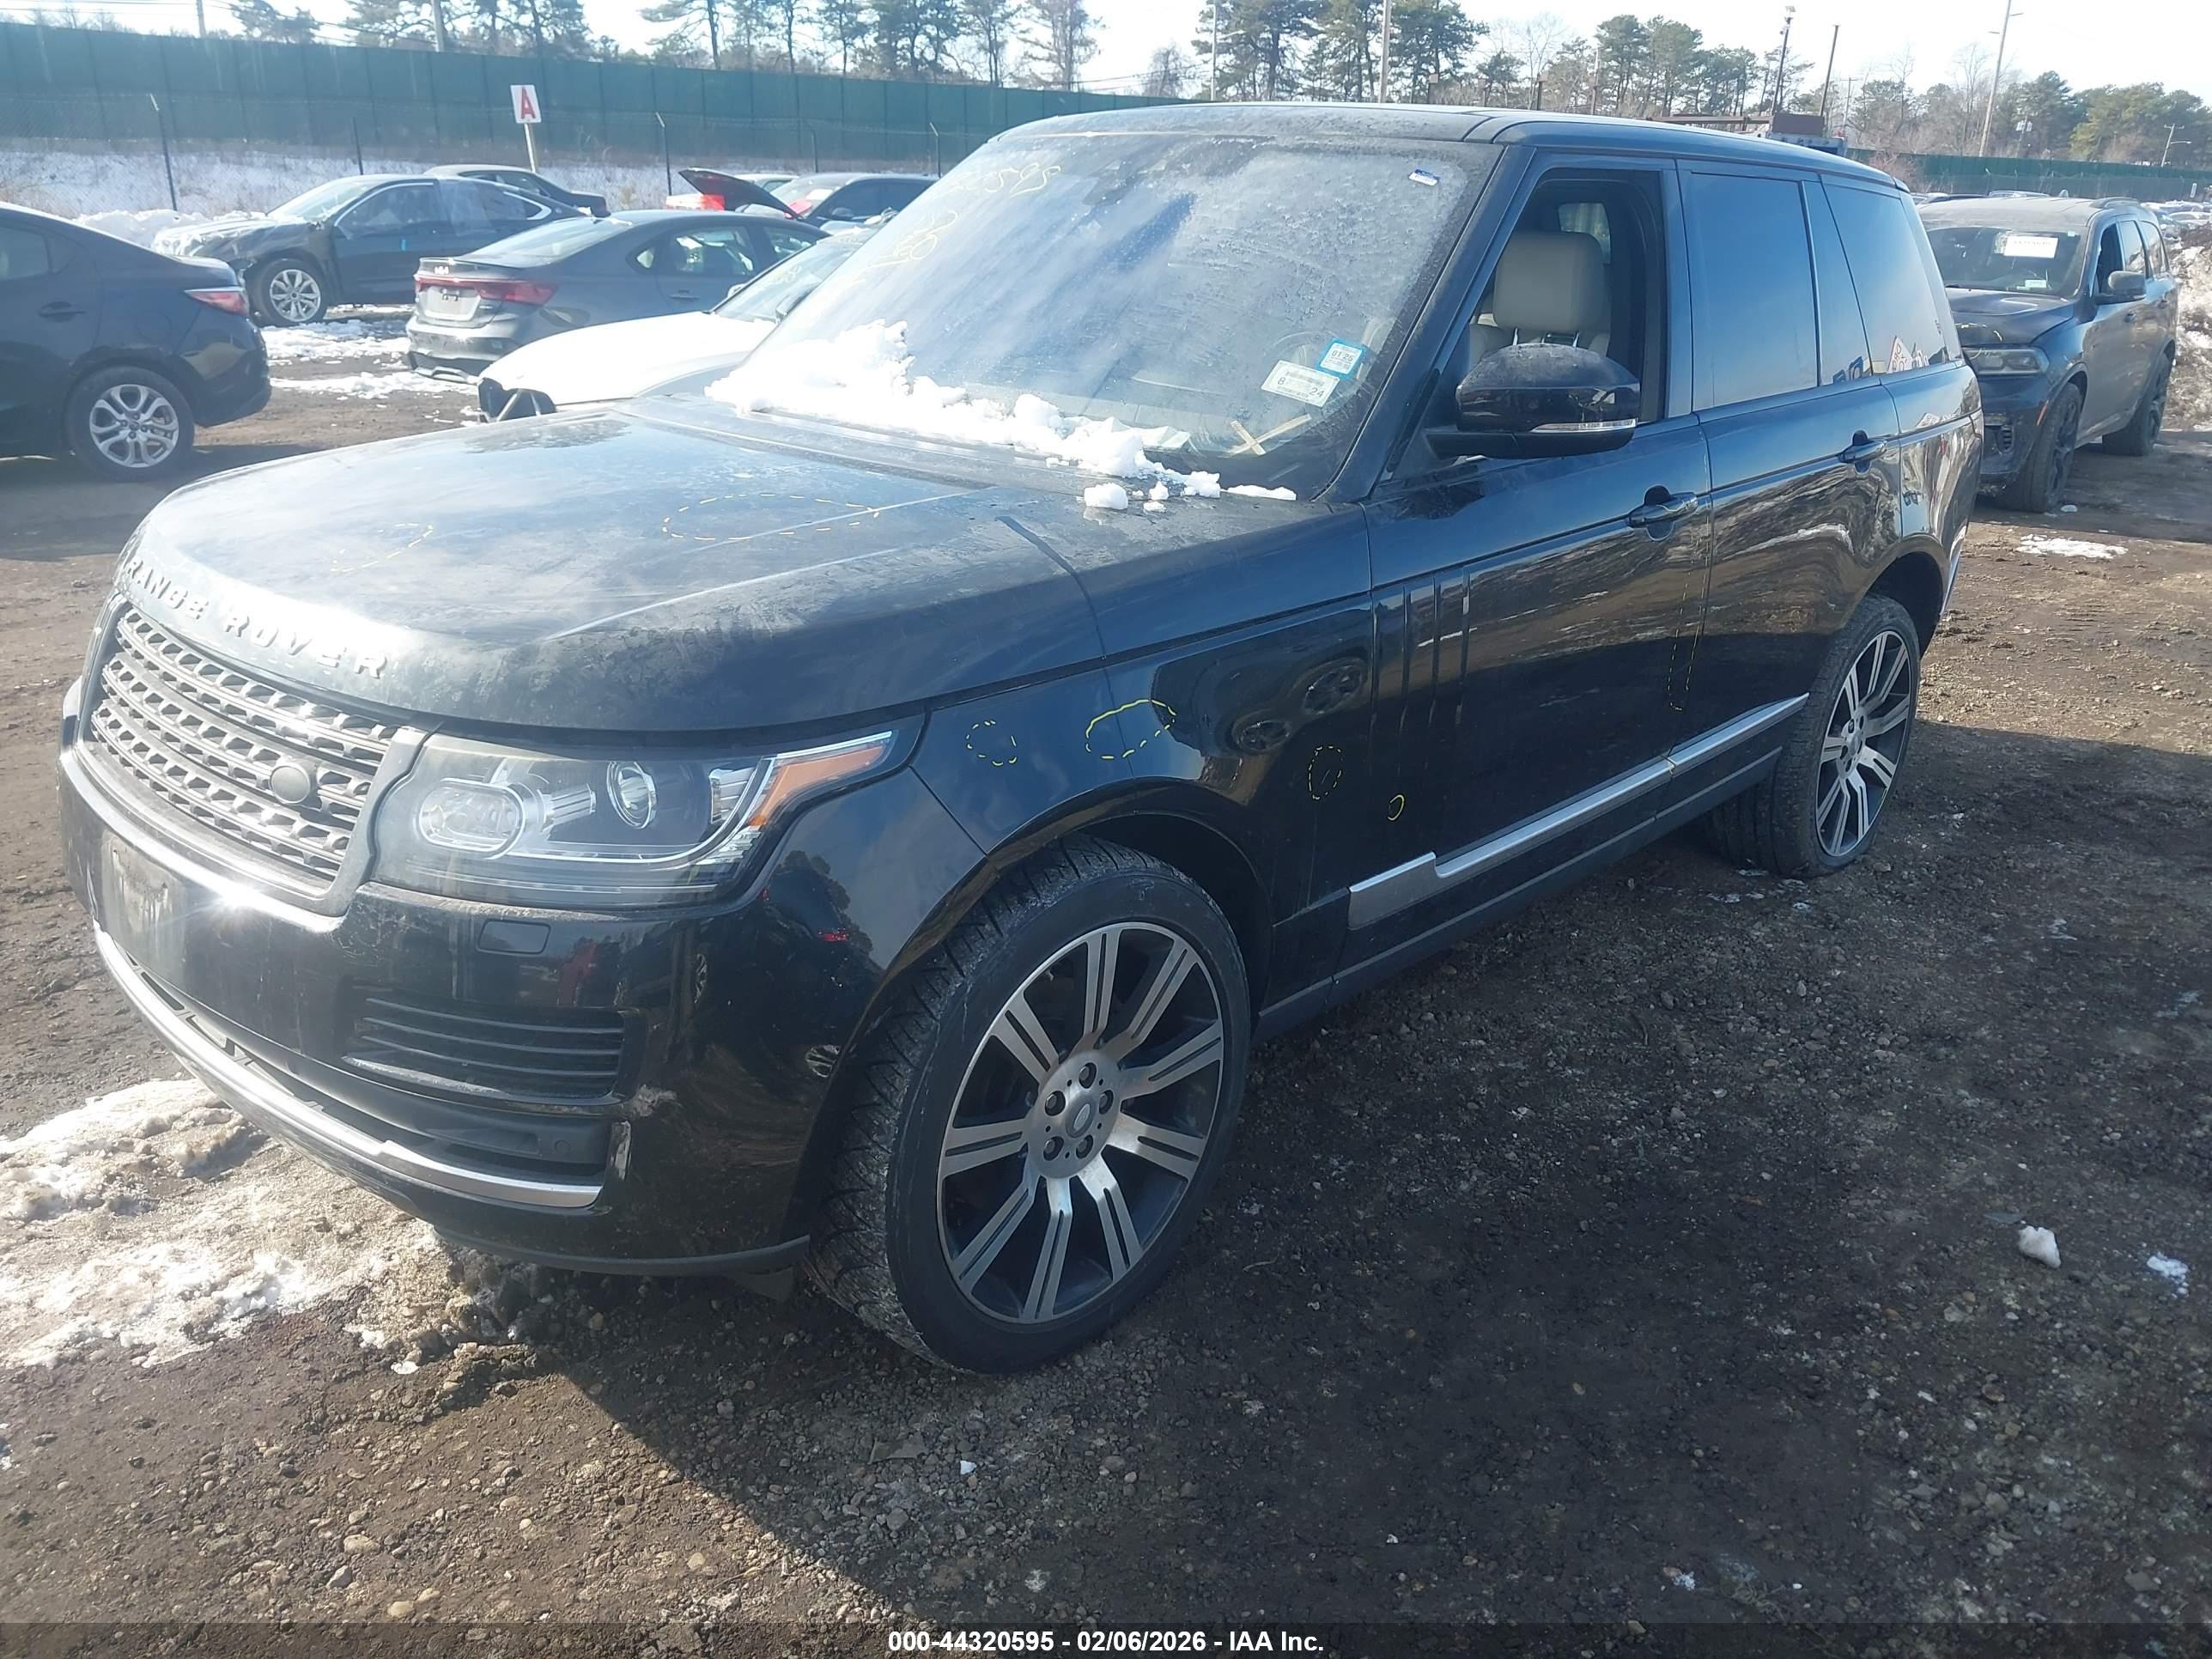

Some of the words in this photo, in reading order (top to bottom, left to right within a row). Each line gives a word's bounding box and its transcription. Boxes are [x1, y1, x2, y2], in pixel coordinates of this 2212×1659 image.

[521, 87, 536, 119] A
[128, 560, 210, 620] RANGE
[225, 611, 387, 679] ROVER
